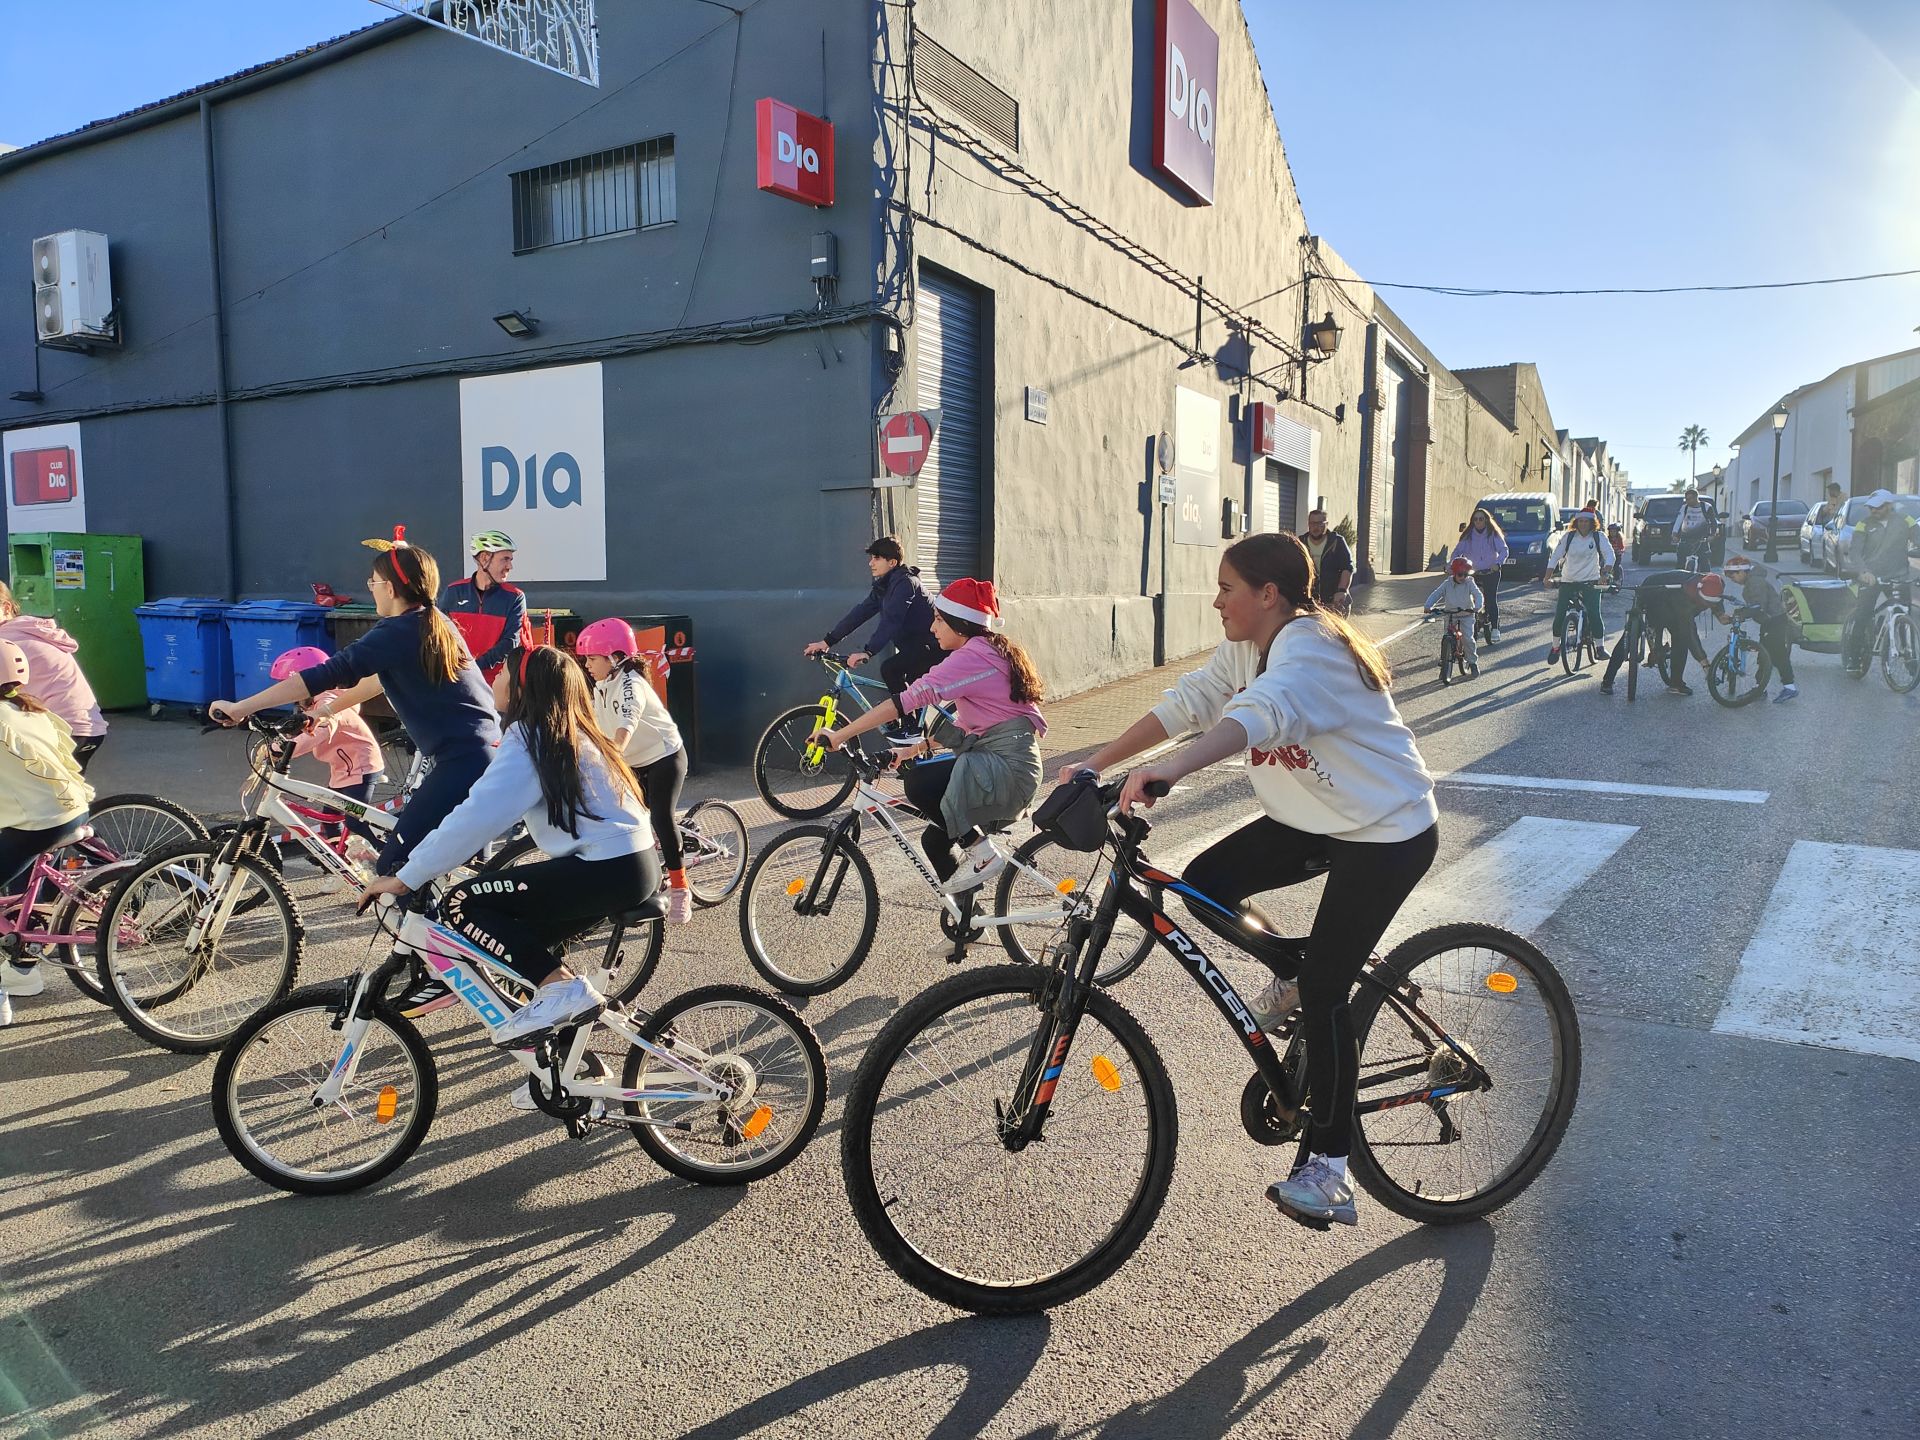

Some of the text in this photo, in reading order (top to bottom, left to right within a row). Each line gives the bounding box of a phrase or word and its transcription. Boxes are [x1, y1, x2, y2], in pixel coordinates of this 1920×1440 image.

[50, 462, 63, 470] CLUB
[448, 880, 515, 957] GOOD DAYS AHEAD
[1165, 929, 1258, 1036] RACER
